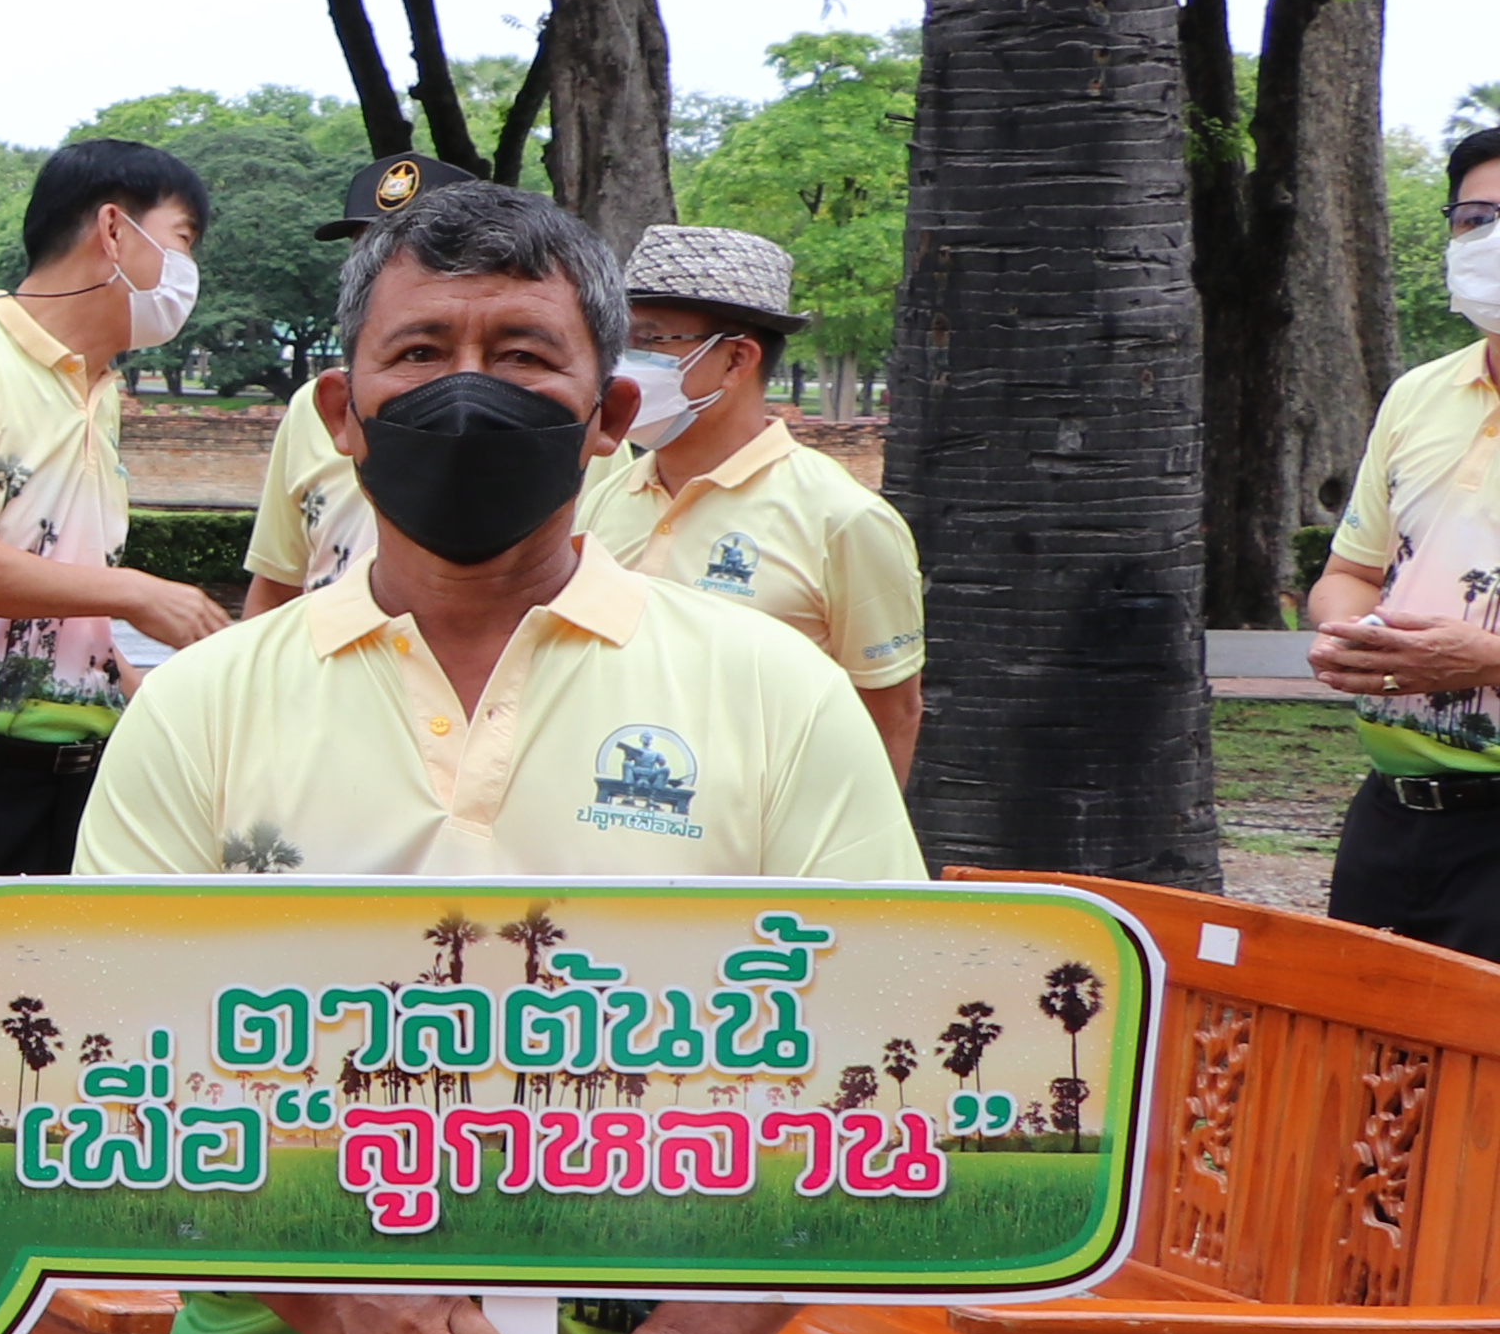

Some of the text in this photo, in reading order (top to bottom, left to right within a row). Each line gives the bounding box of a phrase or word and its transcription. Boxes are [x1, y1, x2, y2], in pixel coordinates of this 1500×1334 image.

[576, 805, 703, 839] ปลูกเพื่อพ่อ
[214, 912, 836, 1073] ตาลต้นนี้
